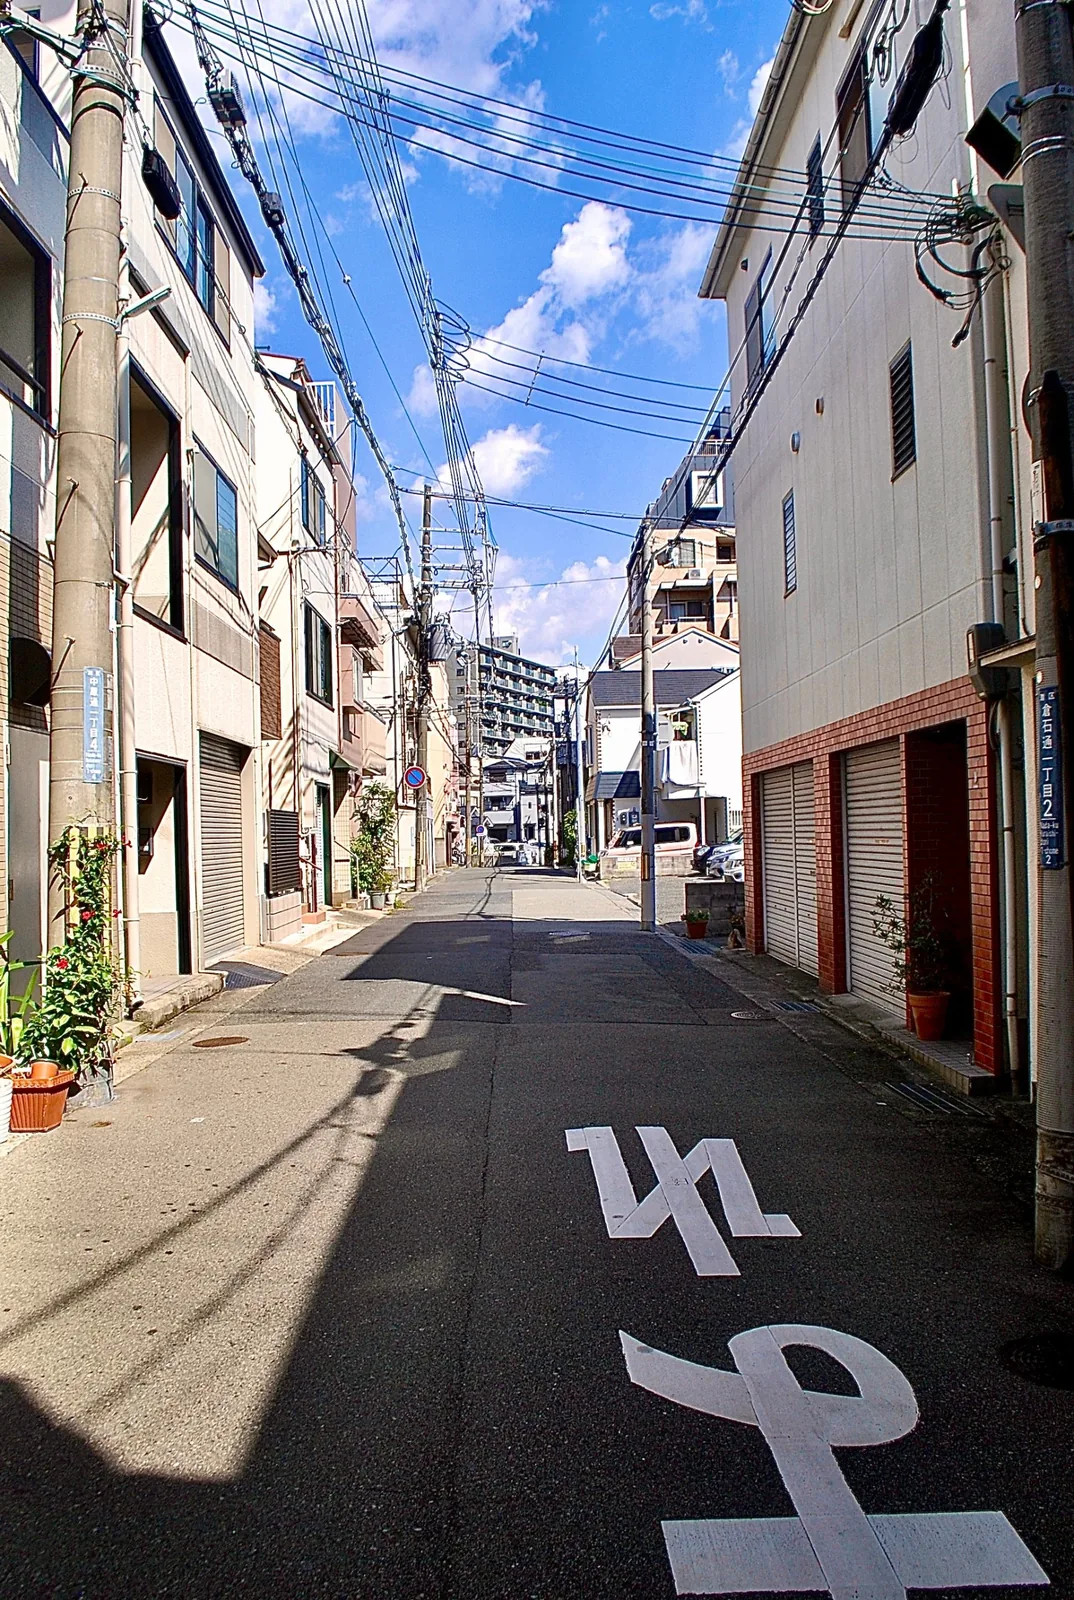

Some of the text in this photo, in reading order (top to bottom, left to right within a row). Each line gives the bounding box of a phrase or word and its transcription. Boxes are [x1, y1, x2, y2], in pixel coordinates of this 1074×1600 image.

[1042, 703, 1053, 817] 倉石通一丁目2
[1046, 855, 1052, 864] 2
